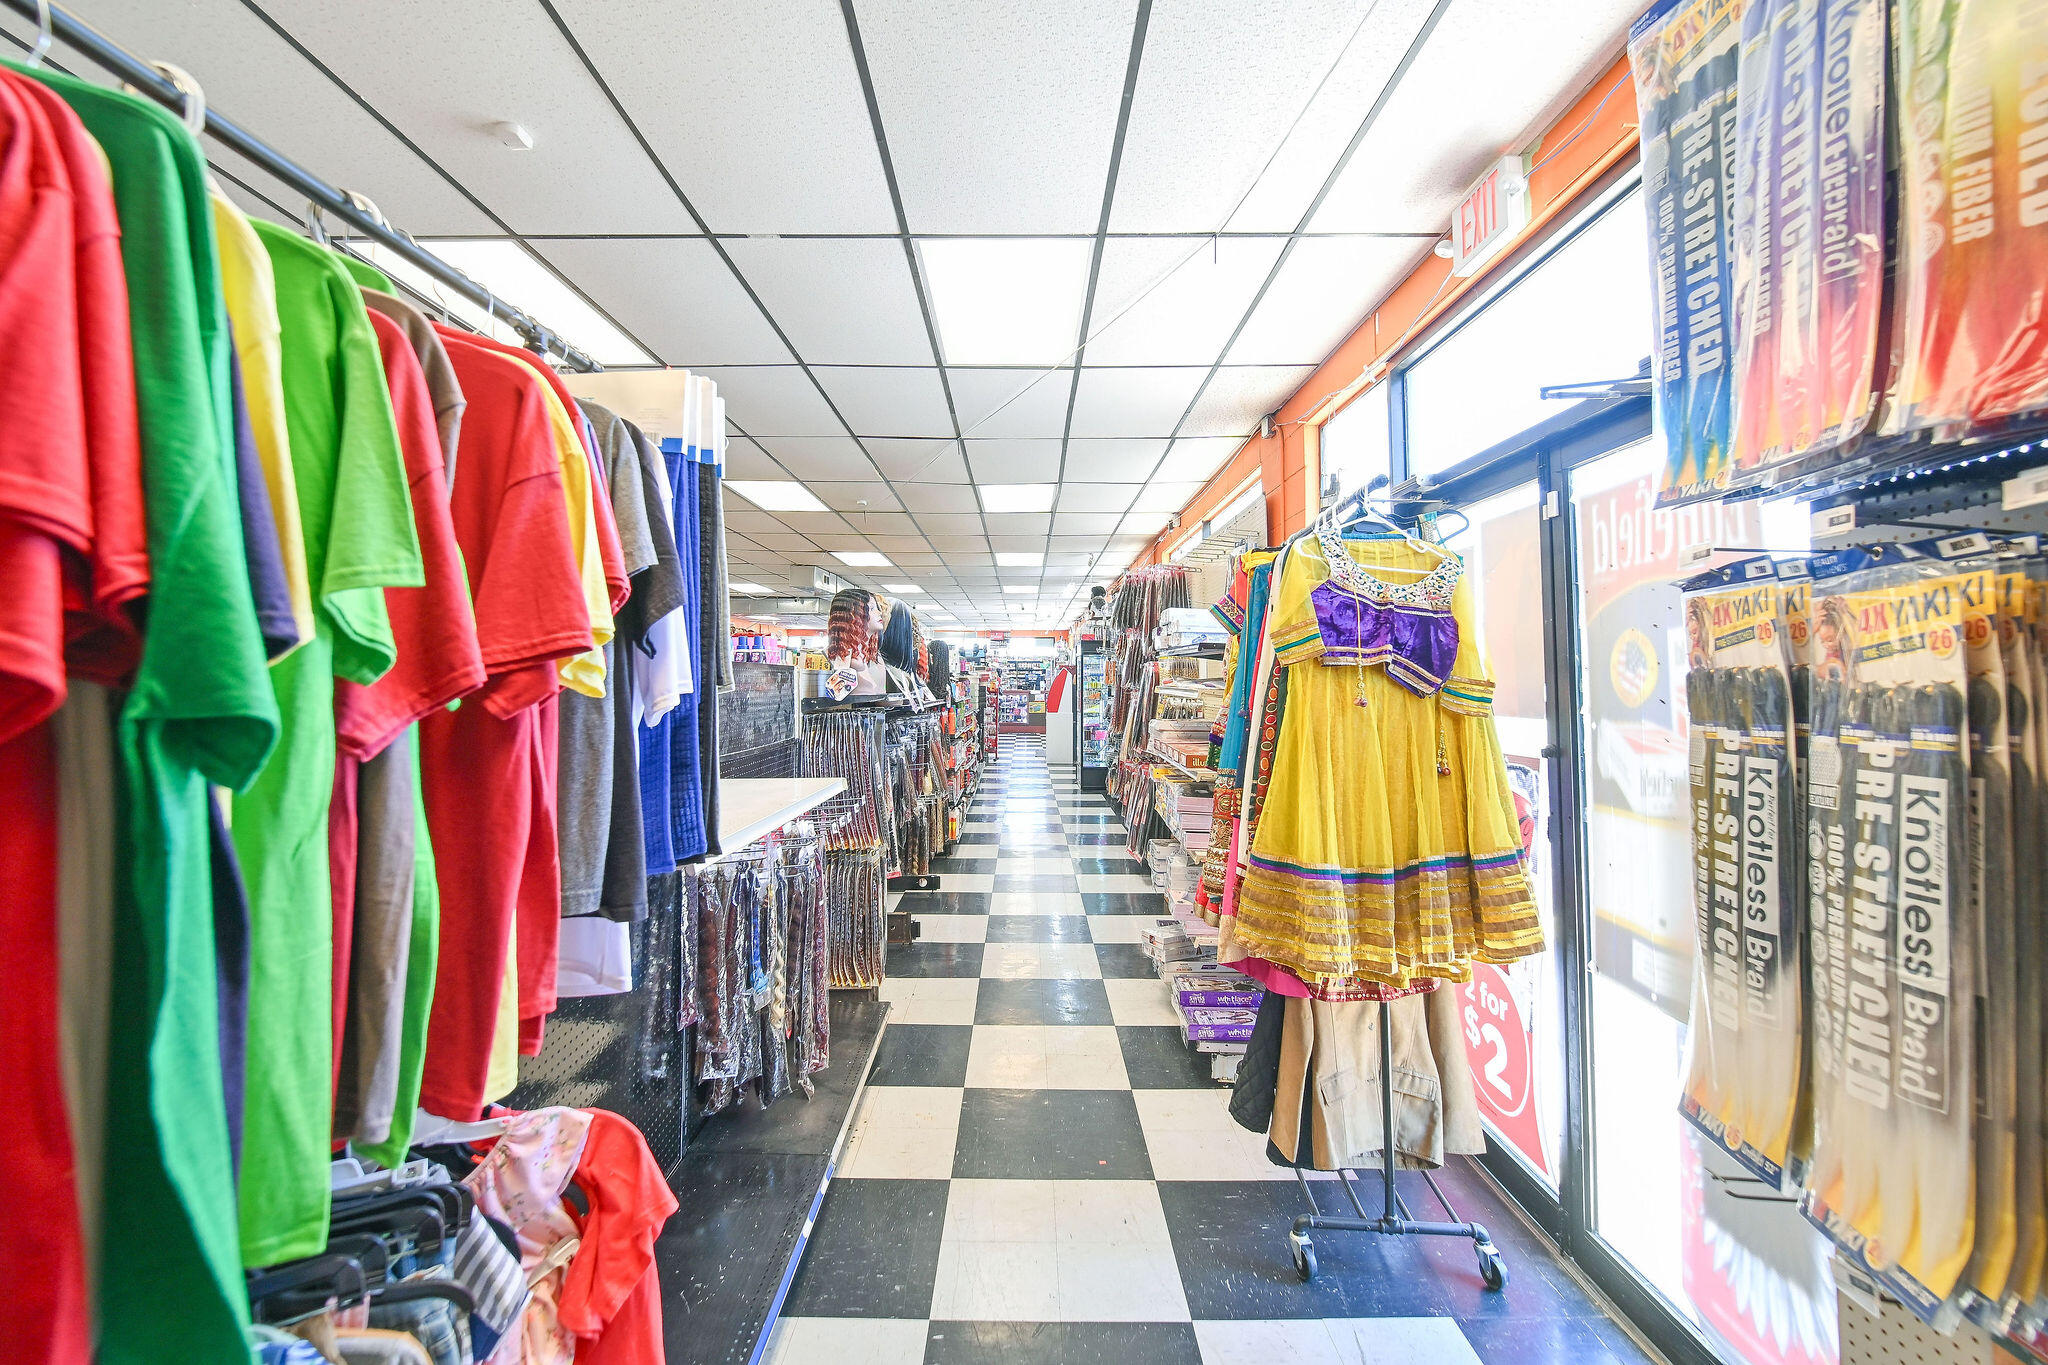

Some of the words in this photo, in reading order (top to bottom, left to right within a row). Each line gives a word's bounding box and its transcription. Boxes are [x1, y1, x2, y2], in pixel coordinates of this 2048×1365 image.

[1460, 168, 1499, 259] EXIT
[1658, 193, 1676, 245] 100%
[1951, 156, 1995, 246] FIBER
[1680, 104, 1724, 376] PRE-STRETCHED
[1732, 587, 1770, 622] YAKI
[1785, 587, 1805, 615] KI
[1889, 585, 1951, 628] YAKI
[1959, 576, 1985, 607] KI
[1757, 621, 1772, 641] 26
[1789, 621, 1807, 640] 26
[1928, 628, 1953, 652] 26
[1964, 618, 1988, 641] 26
[1192, 757, 1207, 767] illu
[1696, 798, 1710, 850] 100%
[1767, 794, 1777, 827] Perfect
[1747, 766, 1774, 924] Knotless
[1826, 823, 1846, 887] 100%
[1712, 727, 1740, 1032] PRE-STRETCHED
[1904, 788, 1943, 979] Knotless
[1826, 891, 1848, 1009] PREMIUM
[1846, 740, 1895, 1110] PRE-STRETCHED
[1479, 980, 1509, 1022] for
[1745, 934, 1777, 1023] Braid
[1464, 1004, 1513, 1101] $2
[1898, 991, 1942, 1102] Braid
